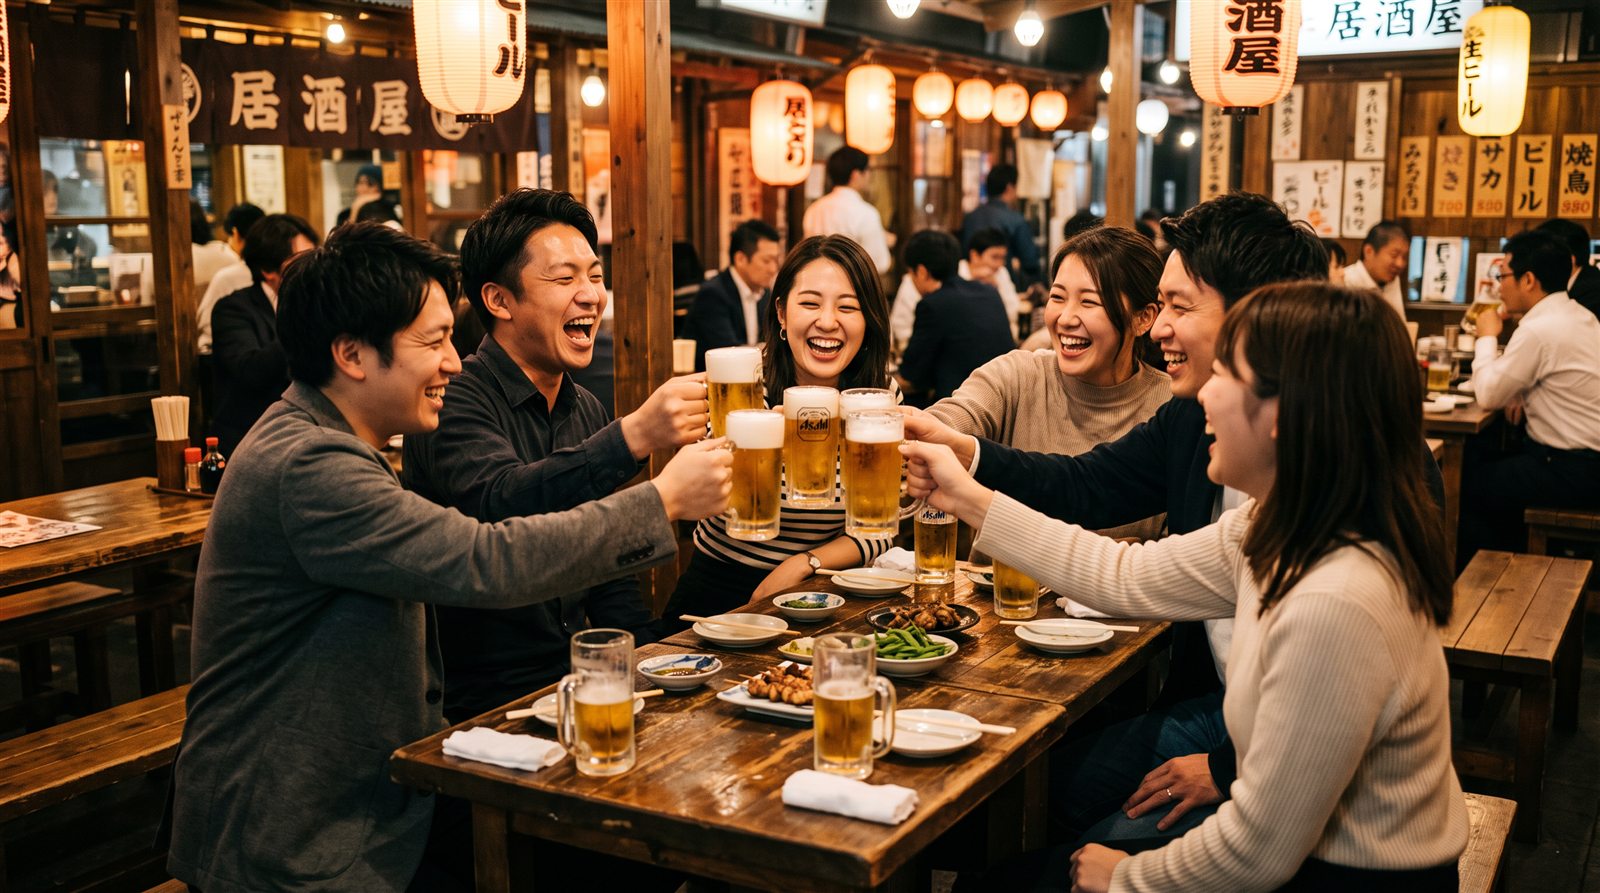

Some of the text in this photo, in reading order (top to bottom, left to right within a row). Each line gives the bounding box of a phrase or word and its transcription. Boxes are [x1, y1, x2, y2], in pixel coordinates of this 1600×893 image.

[1225, 0, 1283, 73] 酒屋
[1328, 0, 1463, 40] 居酒屋
[229, 70, 413, 136] 居酒屋
[1518, 141, 1546, 212] ビール
